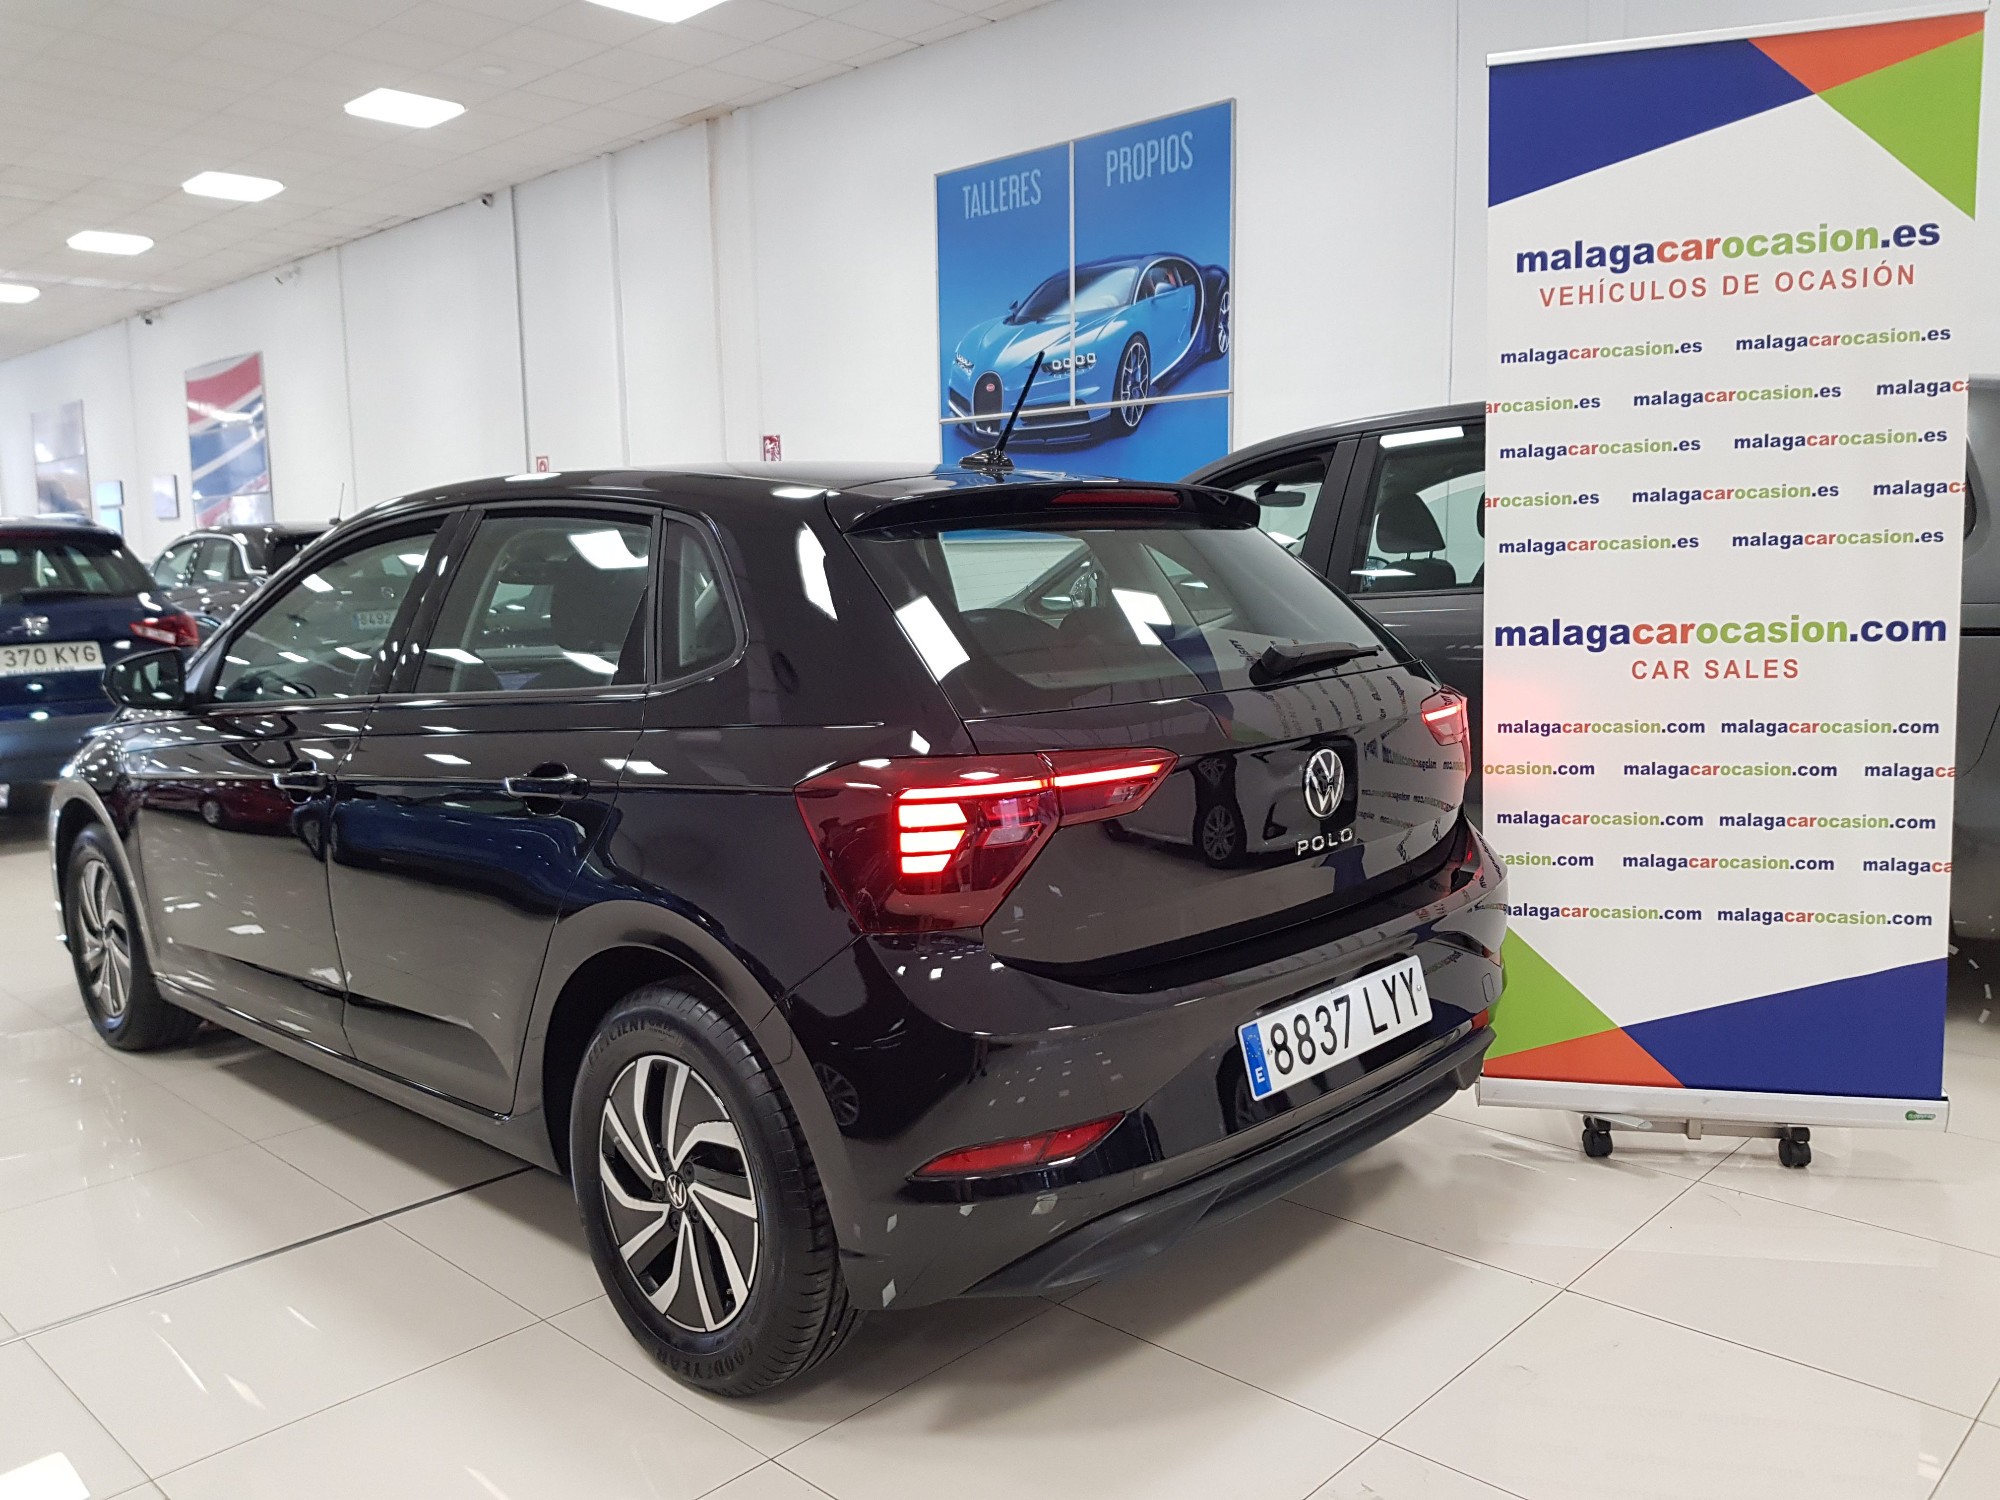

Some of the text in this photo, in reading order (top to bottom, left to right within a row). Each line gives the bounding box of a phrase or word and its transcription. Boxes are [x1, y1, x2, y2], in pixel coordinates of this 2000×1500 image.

[962, 130, 1194, 220] TALLERES PROPIOS
[1516, 222, 1941, 274] malagacarocasion.es
[1540, 262, 1914, 307] VEHÍCULOS DE OCASIÓN
[1500, 328, 1951, 364] malagacarocasion.es malagacarocasion.es
[1633, 385, 1842, 407] malagacarocasion.es
[1500, 429, 1948, 460] malagacarocasion.es malagacarocasion.es
[1632, 484, 1840, 505] malagacarocasion.es
[1499, 529, 1945, 555] malagacarocasion.es malagacarocasion.es
[1495, 615, 1947, 652] malagacarocasion.com
[54, 645, 96, 664] KYG
[1631, 658, 1799, 680] CAR SALES
[1498, 719, 1940, 738] malagacarocasion.com malagacarocasion.com
[1482, 761, 1595, 776] ocasion.com
[1623, 762, 1838, 780] malagacarocasion.com
[1497, 811, 1936, 831] malagacarocasion.com malagacarocasion.com
[1296, 827, 1354, 856] POLO
[1622, 854, 1835, 871] malagacarocasion.com
[1717, 908, 1933, 927] malagacarocasion.com
[1270, 967, 1419, 1076] 8837 LYY
[1254, 1066, 1267, 1084] E
